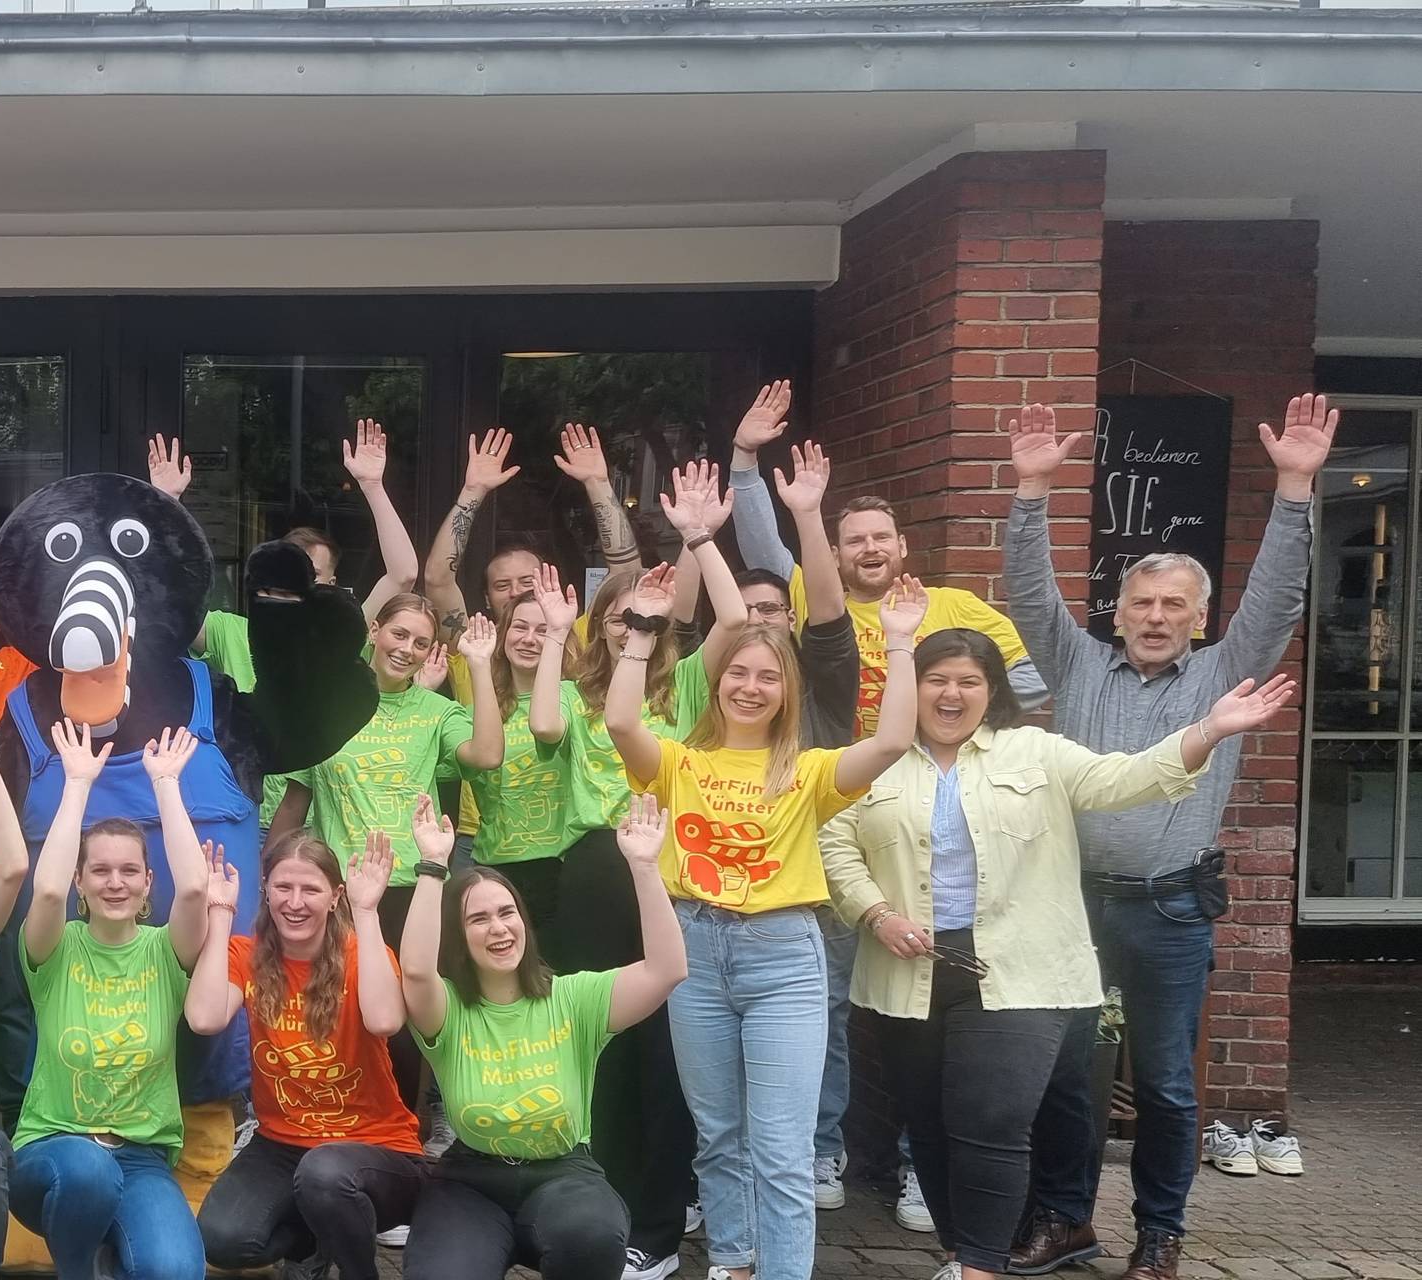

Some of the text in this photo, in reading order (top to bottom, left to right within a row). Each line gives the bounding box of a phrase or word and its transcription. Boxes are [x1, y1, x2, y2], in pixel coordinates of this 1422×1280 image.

[1123, 430, 1202, 465] bedienen
[680, 755, 802, 795] KderFilmst
[481, 1060, 560, 1086] Münster
